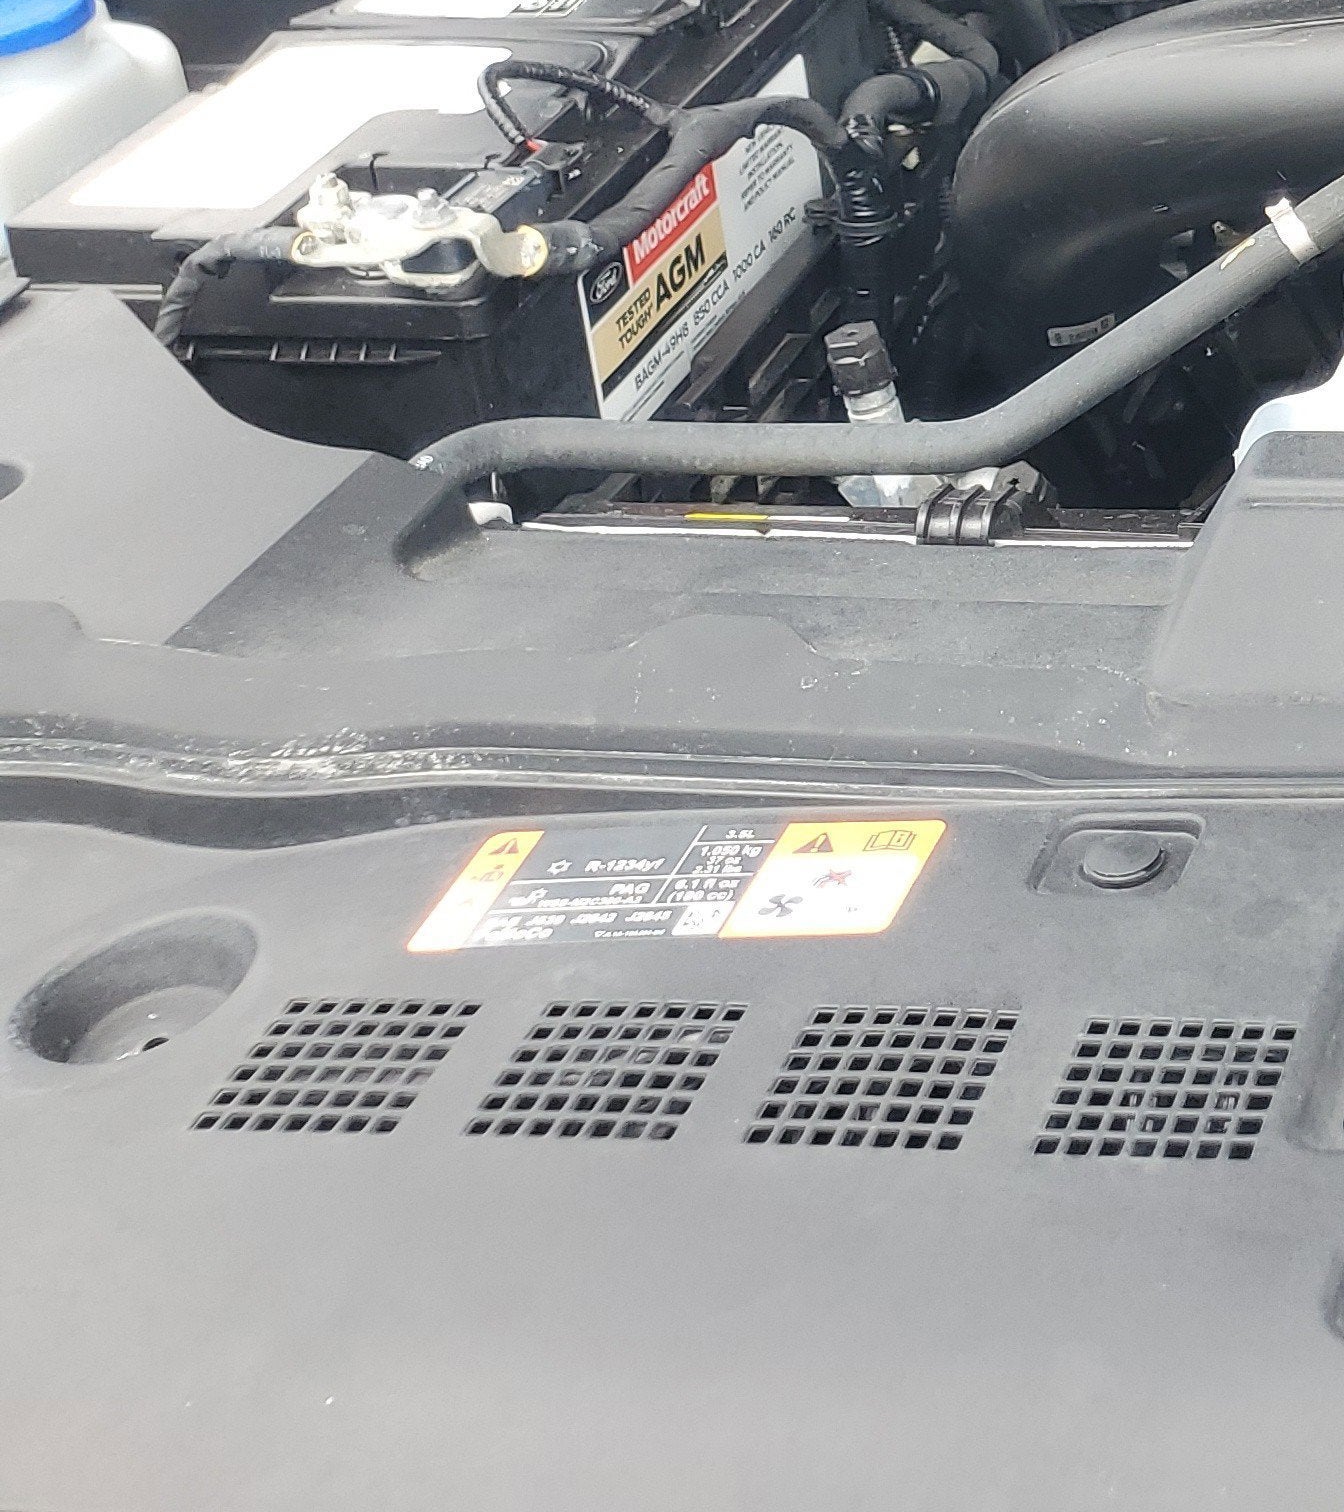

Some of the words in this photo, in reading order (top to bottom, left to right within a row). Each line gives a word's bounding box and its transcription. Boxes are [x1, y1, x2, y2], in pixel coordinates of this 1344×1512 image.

[632, 173, 710, 264] Motorcraft
[656, 233, 705, 311] AGM
[692, 298, 711, 326] 850
[711, 279, 730, 306] CCA
[732, 252, 753, 282] 1000
[753, 239, 766, 260] CA
[783, 206, 796, 227] RC
[615, 288, 650, 331] TESTED
[741, 845, 762, 857] kg
[585, 857, 666, 873] R-1234yf
[608, 882, 651, 896] PAG
[719, 879, 740, 889] oz
[706, 889, 734, 901] cc)
